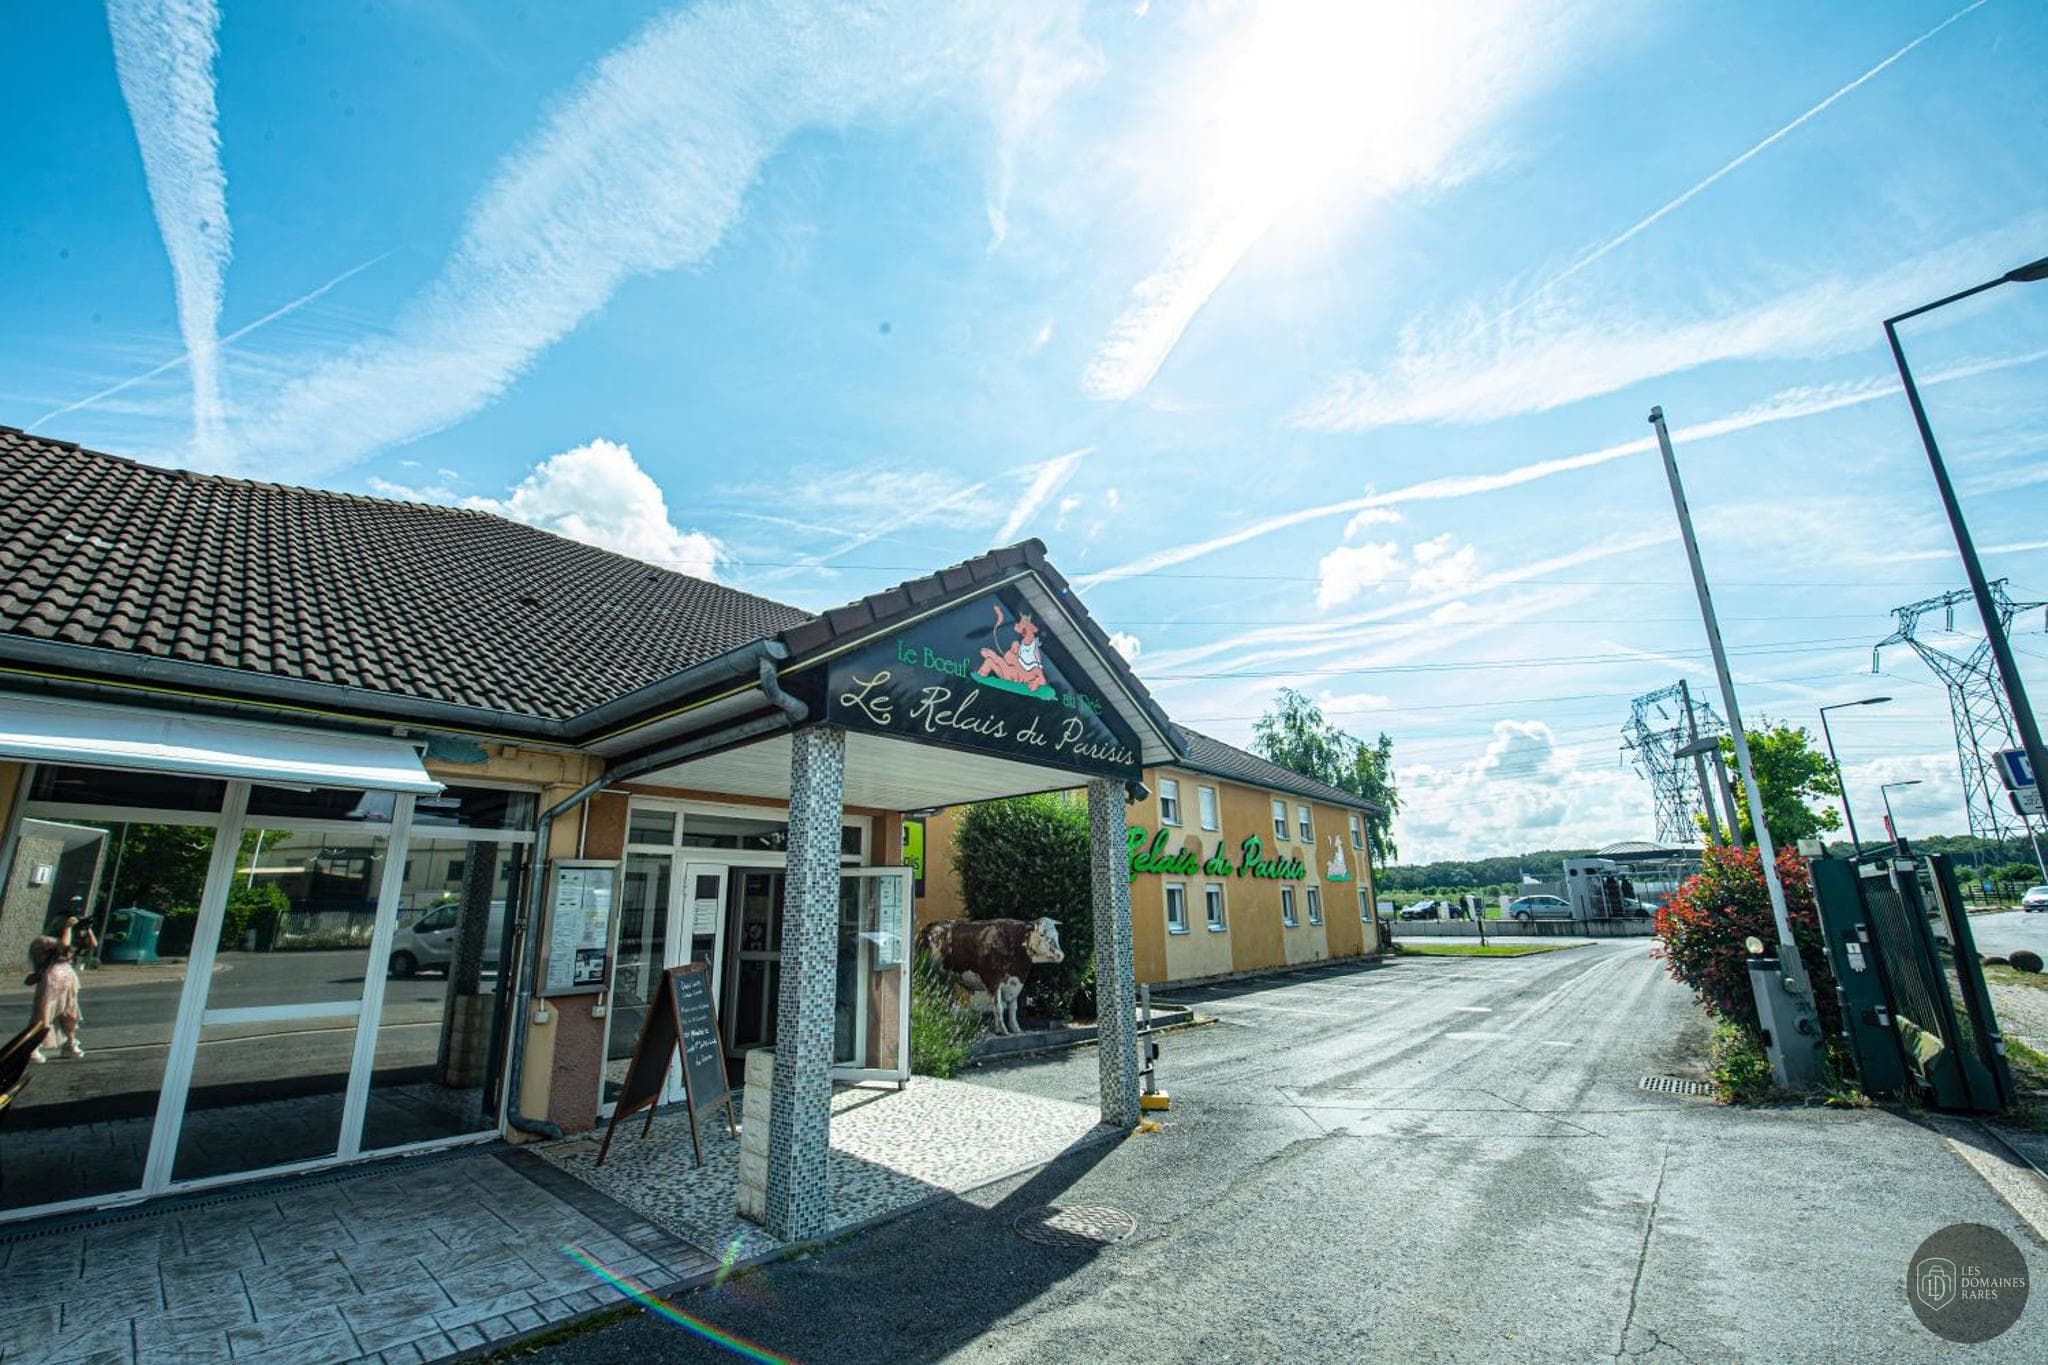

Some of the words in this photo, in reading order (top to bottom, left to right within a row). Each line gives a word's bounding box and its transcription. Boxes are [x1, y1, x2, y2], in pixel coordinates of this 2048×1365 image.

[897, 637, 917, 664] Le
[923, 646, 970, 678] Bœuf
[840, 671, 893, 725] Le
[909, 686, 1007, 738] Relais
[1016, 716, 1047, 746] du
[1055, 716, 1135, 765] Parisis
[1203, 840, 1233, 877] du
[1237, 834, 1306, 881] Parisis
